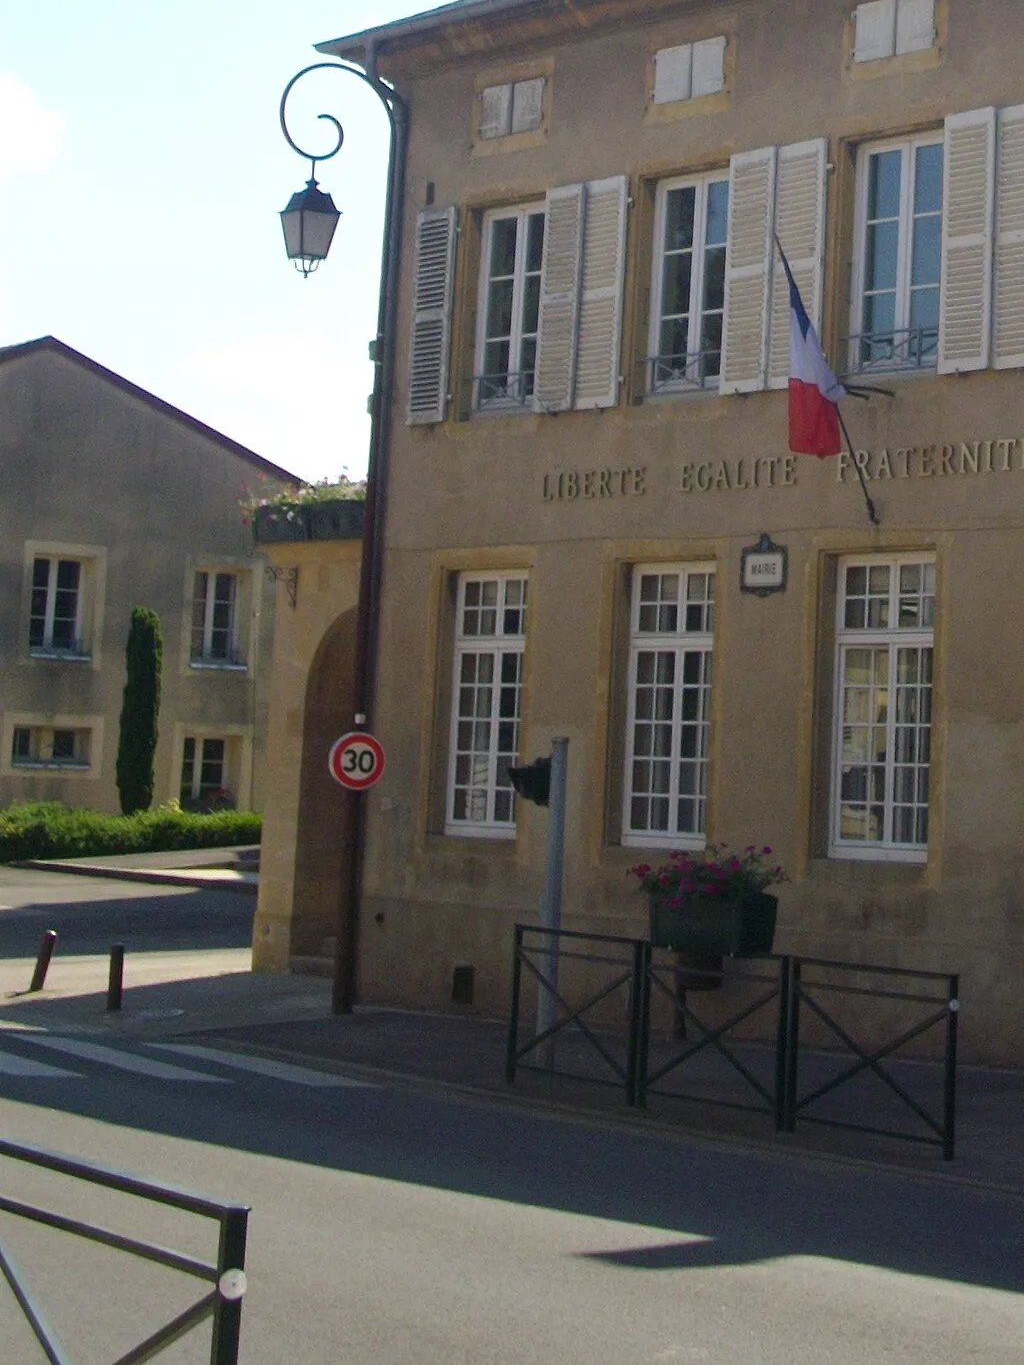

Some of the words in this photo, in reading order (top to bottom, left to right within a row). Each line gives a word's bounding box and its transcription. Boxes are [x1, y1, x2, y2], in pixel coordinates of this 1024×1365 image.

[541, 466, 647, 502] LIBERTE
[677, 455, 799, 492] EGALITE
[751, 562, 776, 575] MAIRIE
[343, 749, 374, 773] 30
